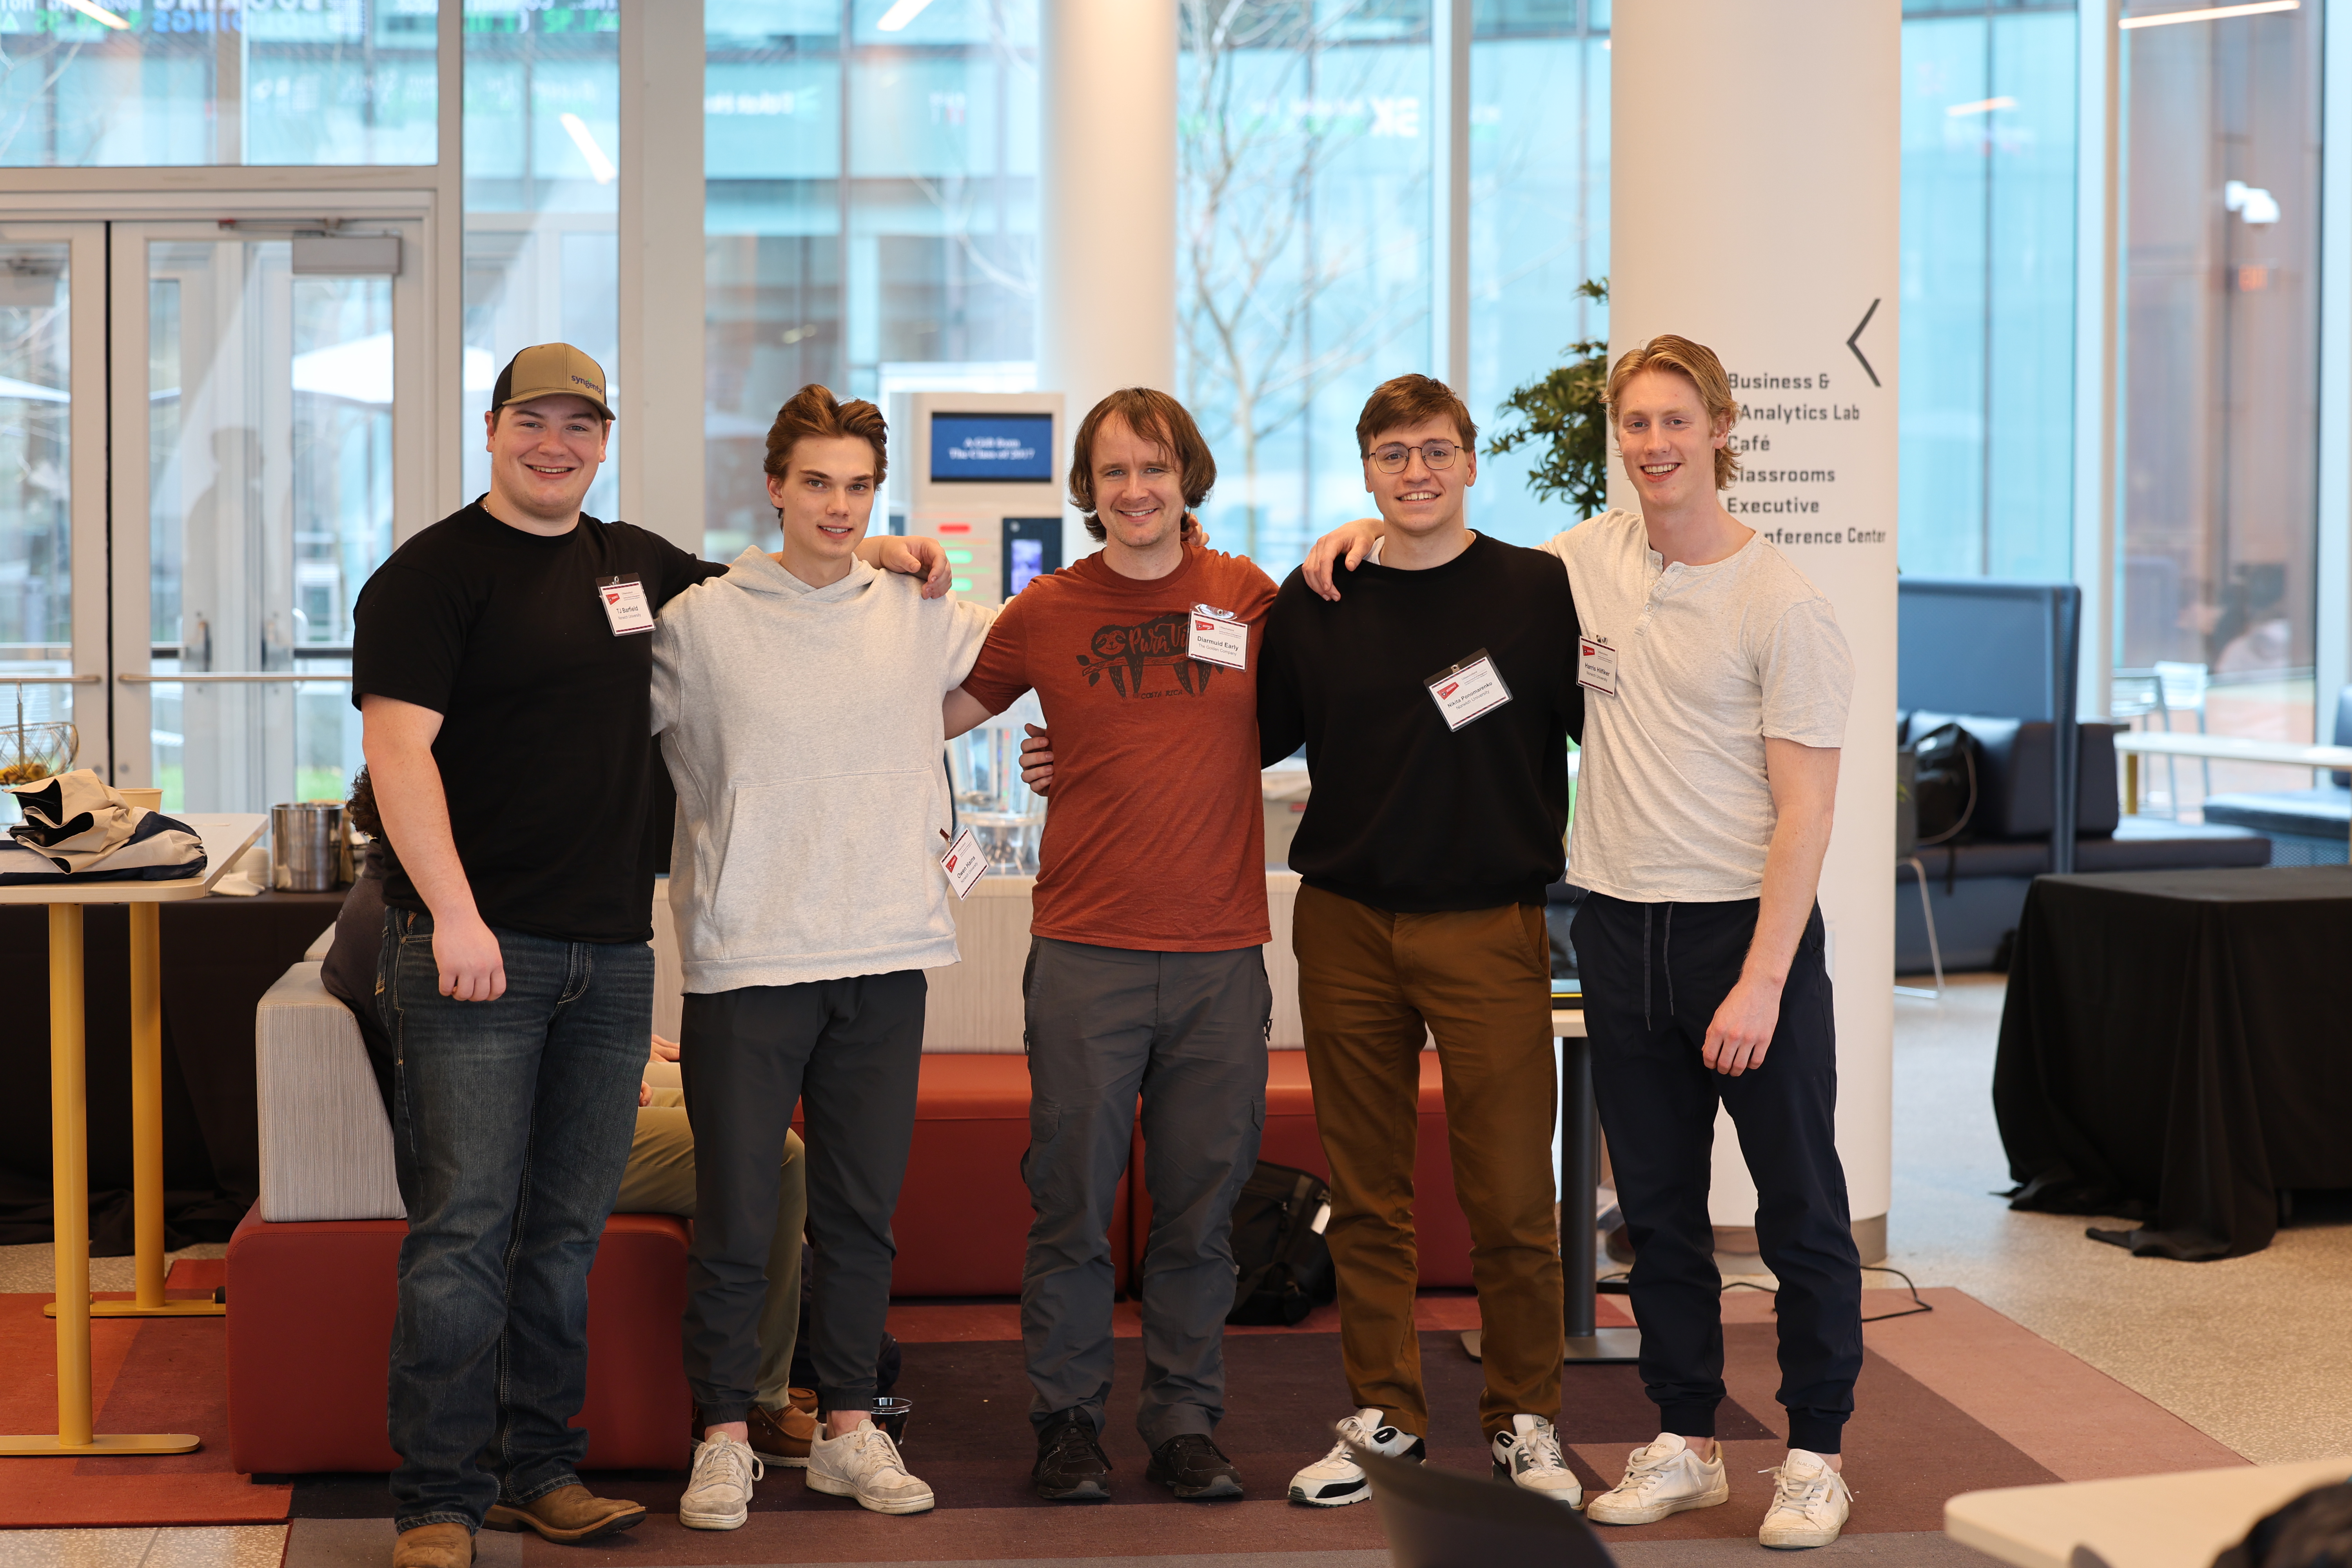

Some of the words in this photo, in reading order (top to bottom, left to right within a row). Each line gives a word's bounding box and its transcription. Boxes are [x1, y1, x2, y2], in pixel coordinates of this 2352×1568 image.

[571, 375, 602, 395] syngenta
[1728, 373, 1812, 388] Business
[1819, 373, 1830, 388] &
[1742, 404, 1828, 424] Analytics
[1834, 404, 1860, 420] Lab
[1728, 435, 1770, 450] Café
[1735, 466, 1835, 482] lassrooms
[1727, 497, 1820, 513] Executive
[1765, 528, 1842, 544] nference
[1848, 528, 1886, 544] Center
[1129, 627, 1170, 654] Pura
[1198, 636, 1223, 646] Diarmuid
[1224, 642, 1239, 651] Early
[1585, 662, 1596, 671] Harris
[1597, 667, 1610, 677] Hilfiker
[1596, 674, 1608, 683] University
[1141, 691, 1162, 699] COSTA
[1447, 697, 1461, 708] Nikita
[1461, 682, 1493, 701] Ponomarenko
[1455, 700, 1472, 710] Norwich
[1472, 690, 1490, 702] University
[957, 866, 967, 878] Owen
[966, 855, 976, 868] Hains
[960, 873, 969, 884] Norwich
[968, 862, 978, 875] University
